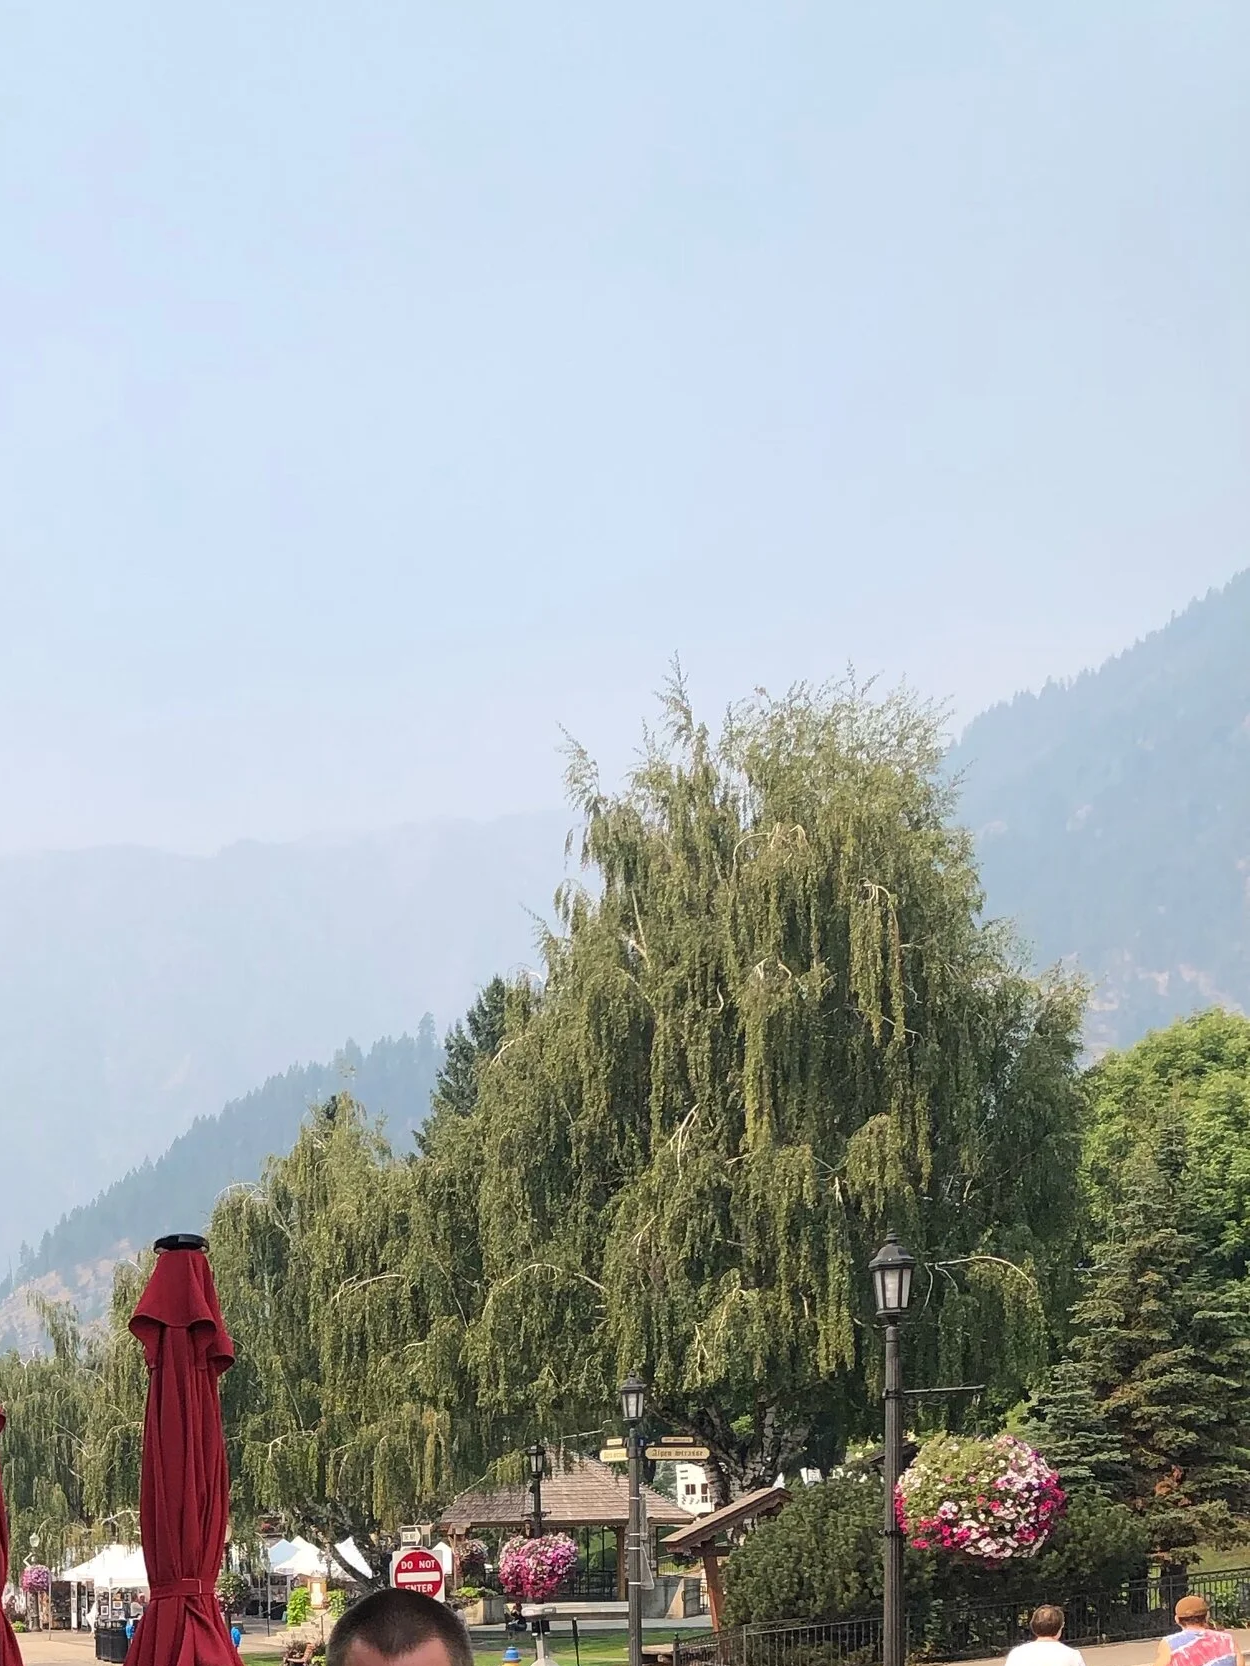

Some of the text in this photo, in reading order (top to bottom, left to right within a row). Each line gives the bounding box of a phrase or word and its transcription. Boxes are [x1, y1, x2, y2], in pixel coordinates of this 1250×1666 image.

[651, 1449, 704, 1458] Alpen Strasse
[401, 1560, 436, 1570] DO NOT
[405, 1583, 433, 1593] ENTER
